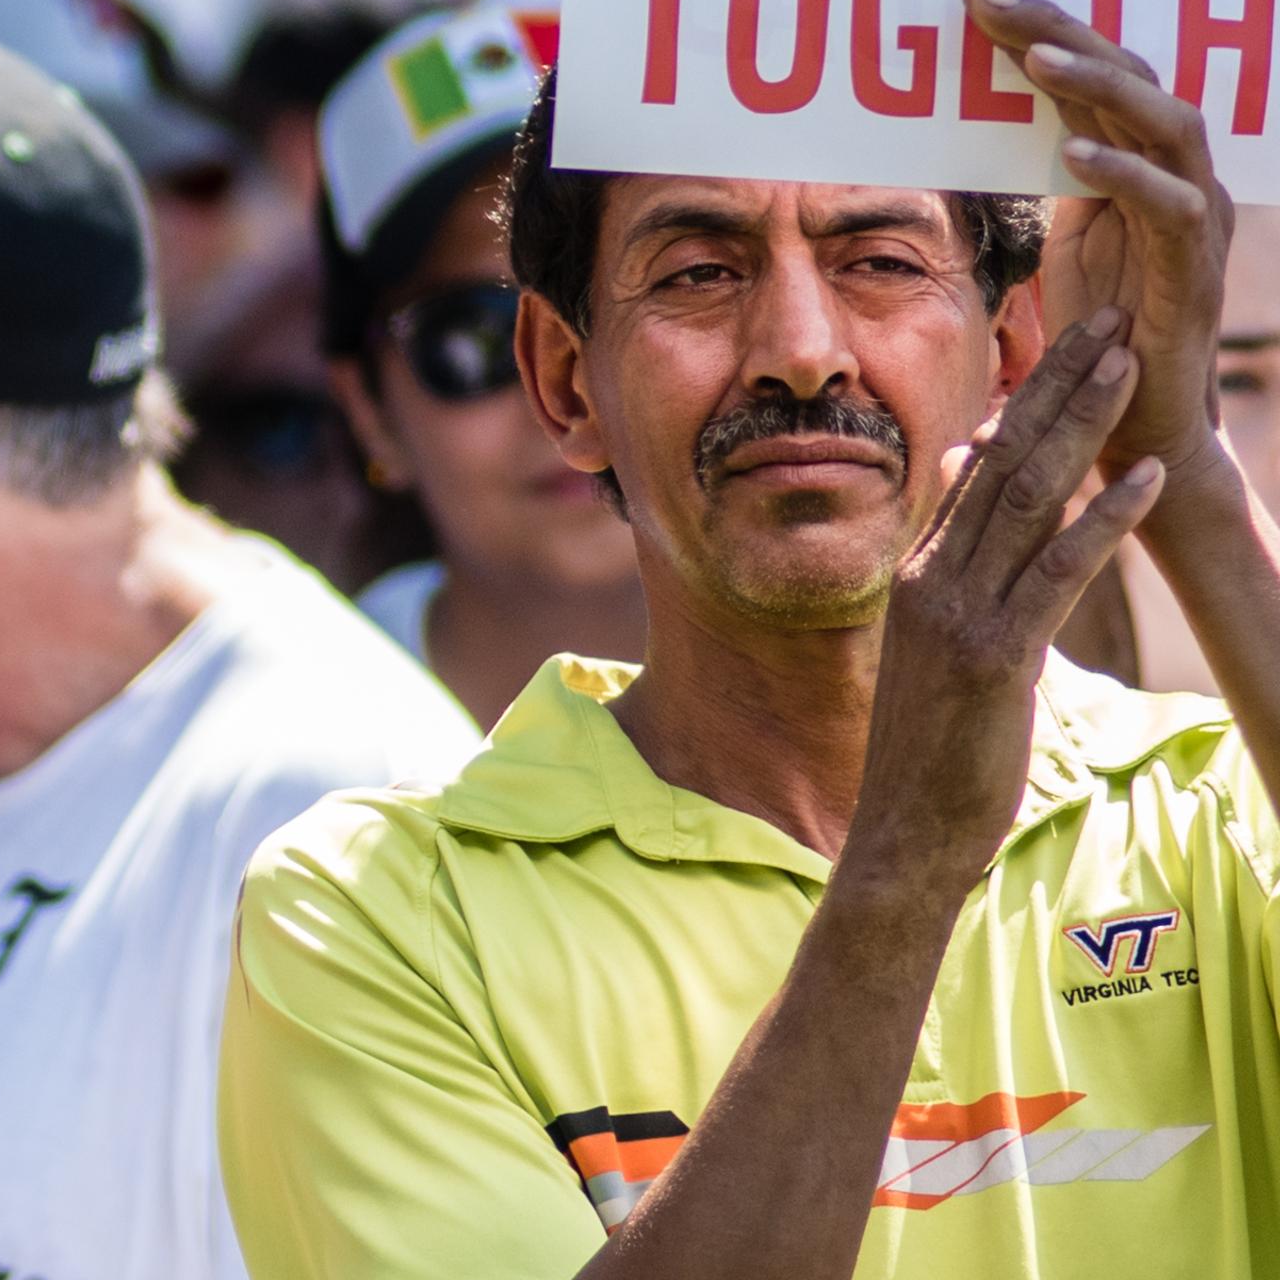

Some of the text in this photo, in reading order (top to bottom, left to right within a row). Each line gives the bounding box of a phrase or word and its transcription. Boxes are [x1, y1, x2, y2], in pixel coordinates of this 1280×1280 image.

[1063, 909, 1180, 978] VT
[1062, 967, 1199, 1007] VIRGINIA TEC
